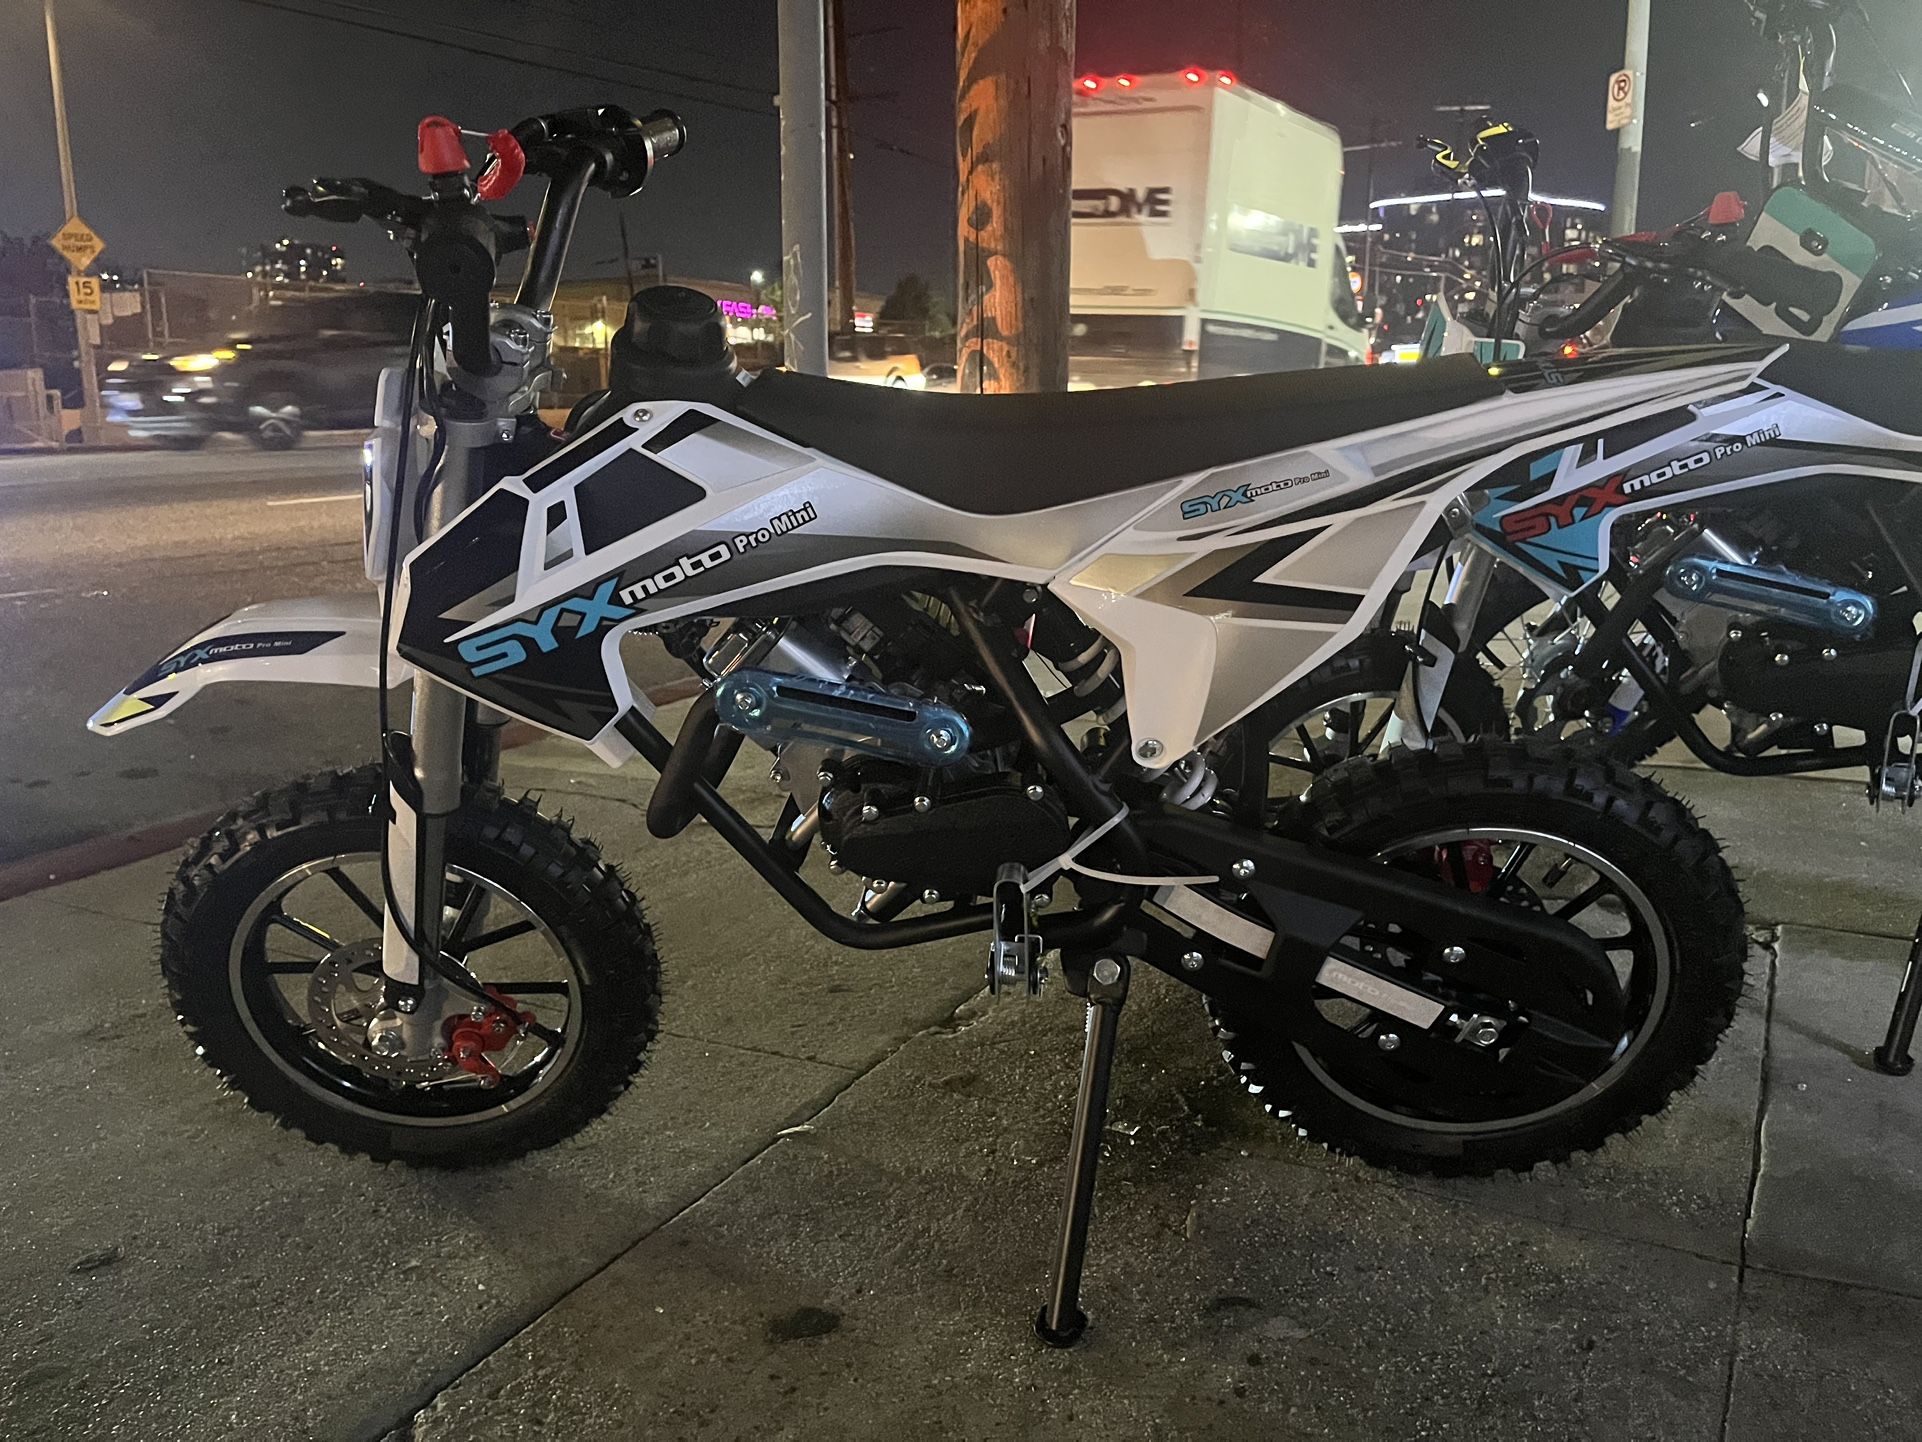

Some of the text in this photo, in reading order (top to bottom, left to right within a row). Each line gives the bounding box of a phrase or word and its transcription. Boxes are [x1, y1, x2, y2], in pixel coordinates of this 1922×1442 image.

[75, 280, 94, 297] 15
[1714, 441, 1743, 460] Pro
[1745, 423, 1781, 448] Mini
[1293, 476, 1311, 486] Pro
[1311, 469, 1330, 481] Mini
[735, 527, 771, 553] Pro
[770, 502, 817, 536] Mini
